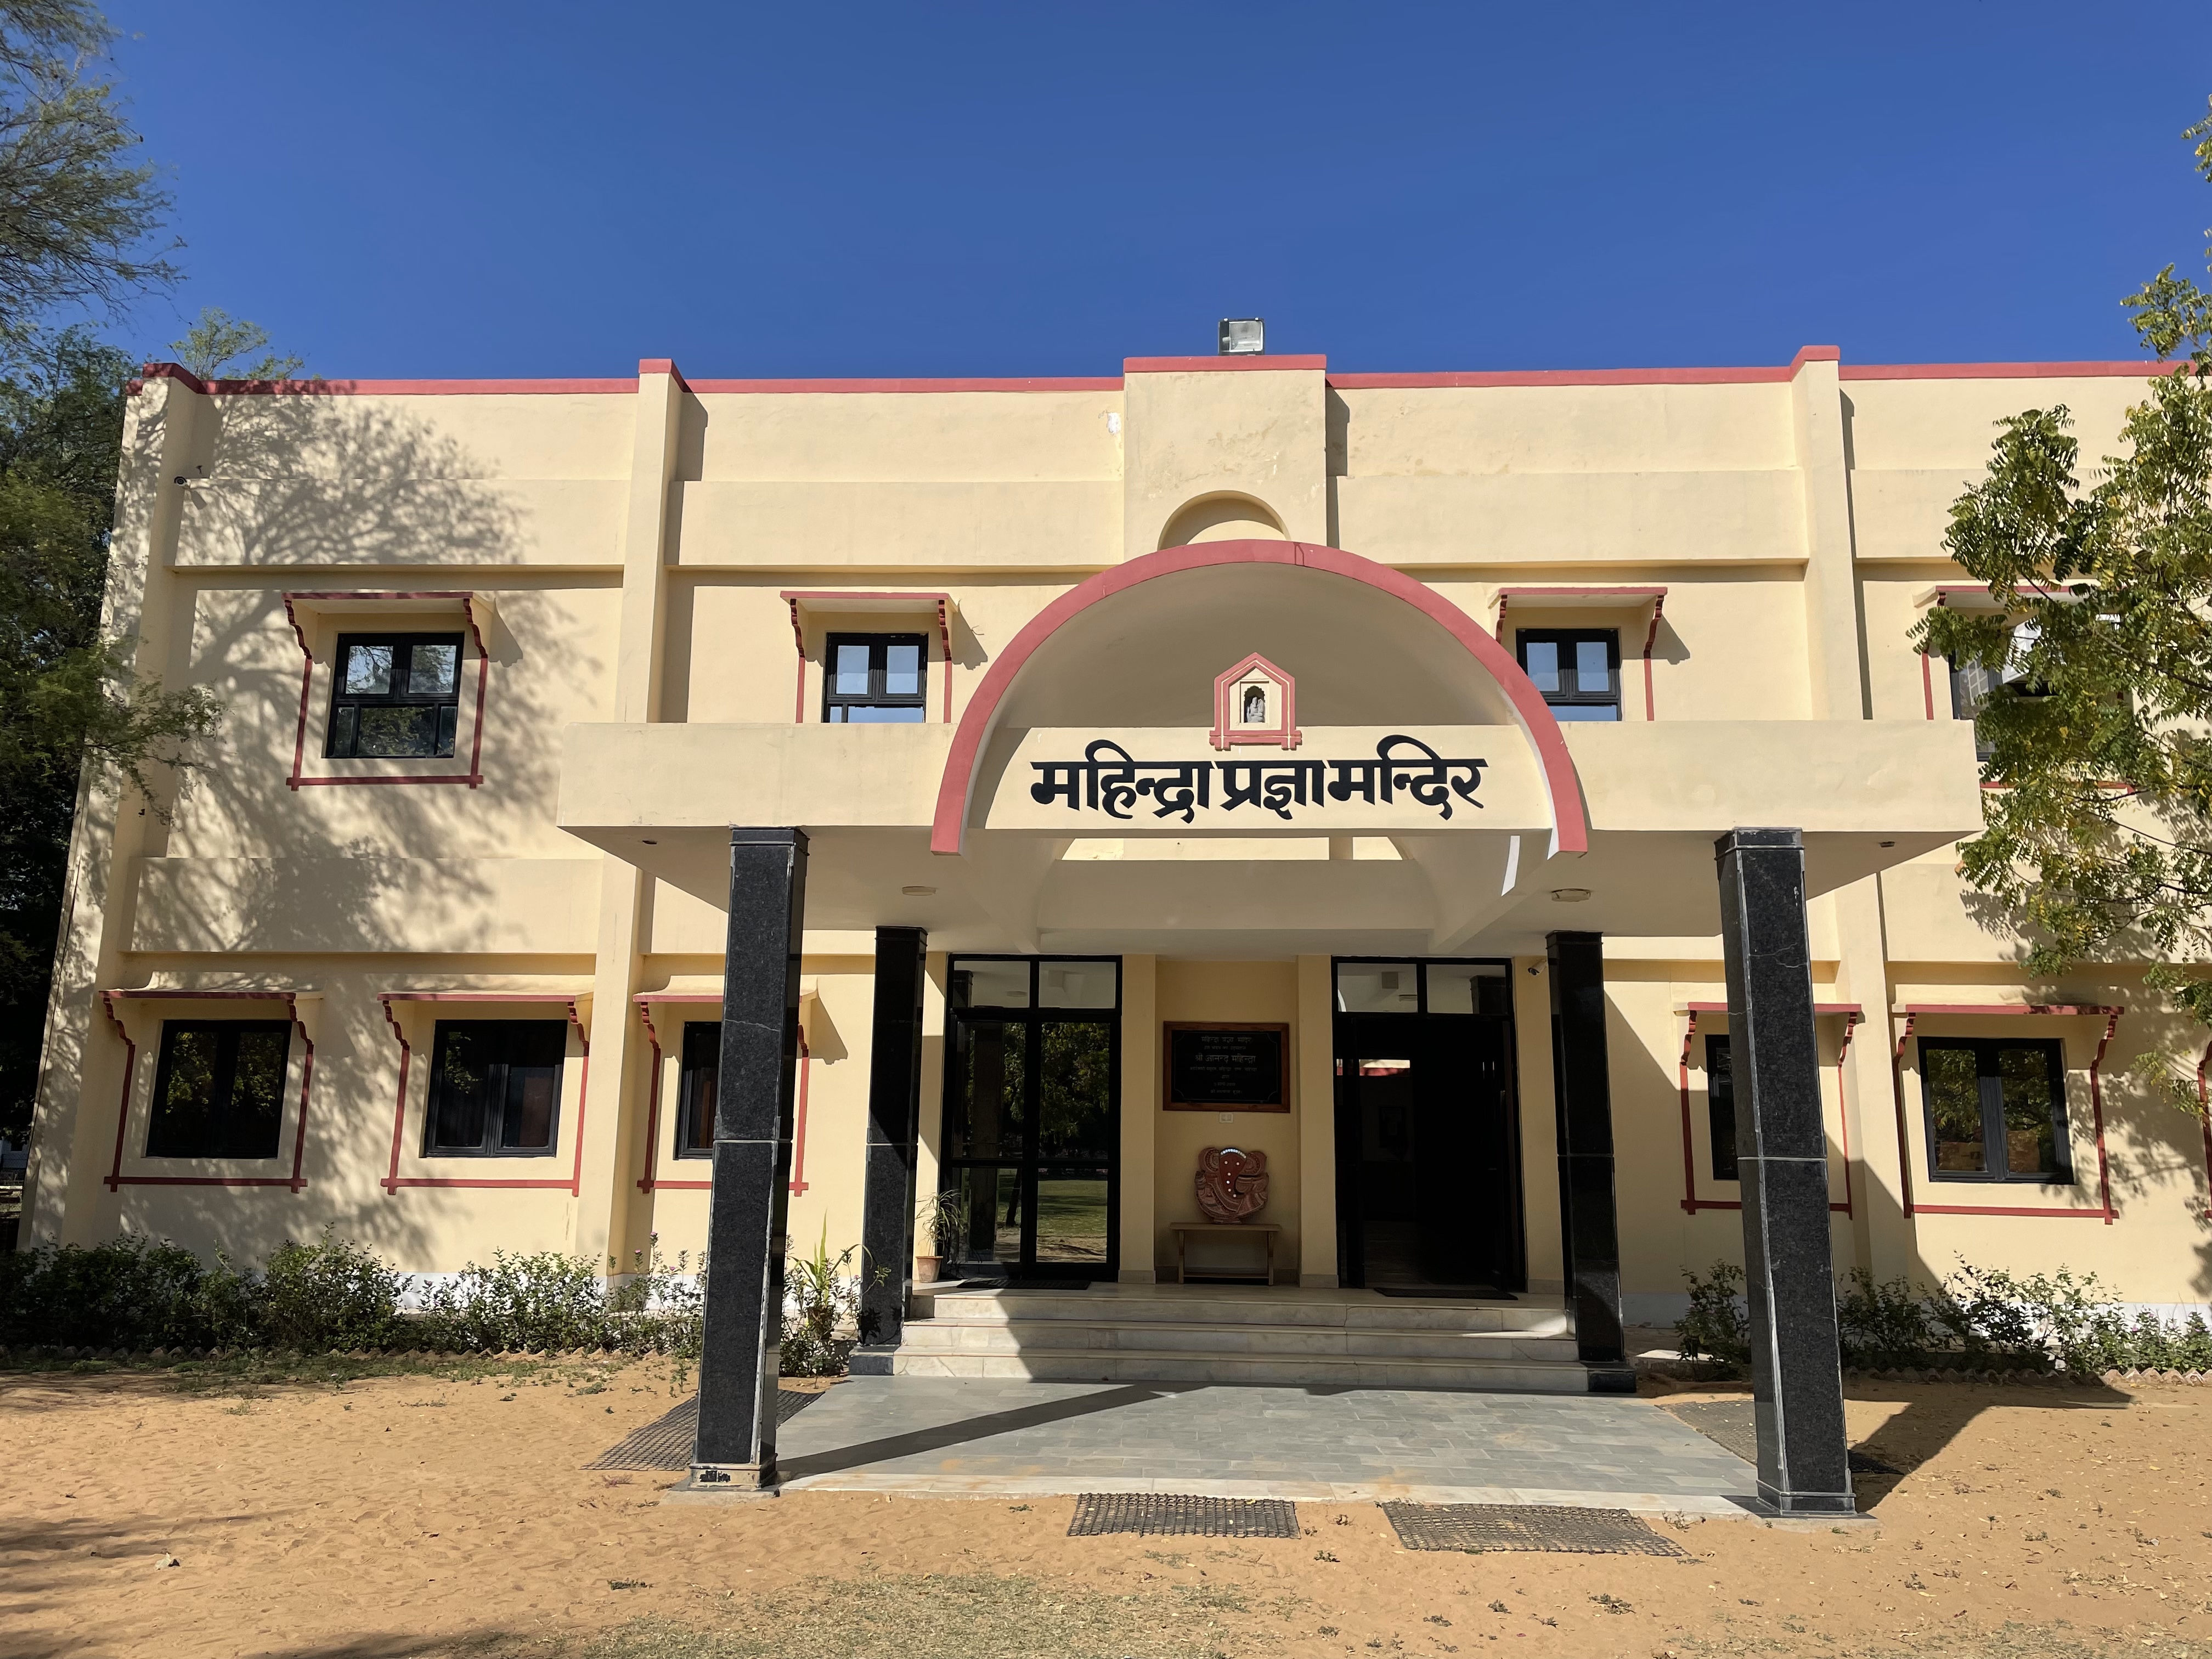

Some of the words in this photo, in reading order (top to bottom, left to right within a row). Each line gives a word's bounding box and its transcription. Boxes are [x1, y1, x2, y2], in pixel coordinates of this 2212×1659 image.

[1029, 739, 1214, 823] महिन्द्रा
[1215, 760, 1326, 820] प्रज्ञा
[1327, 735, 1489, 821] मन्दिर
[1195, 1053, 1203, 1062] श्री
[1205, 1054, 1229, 1064] आनन्द
